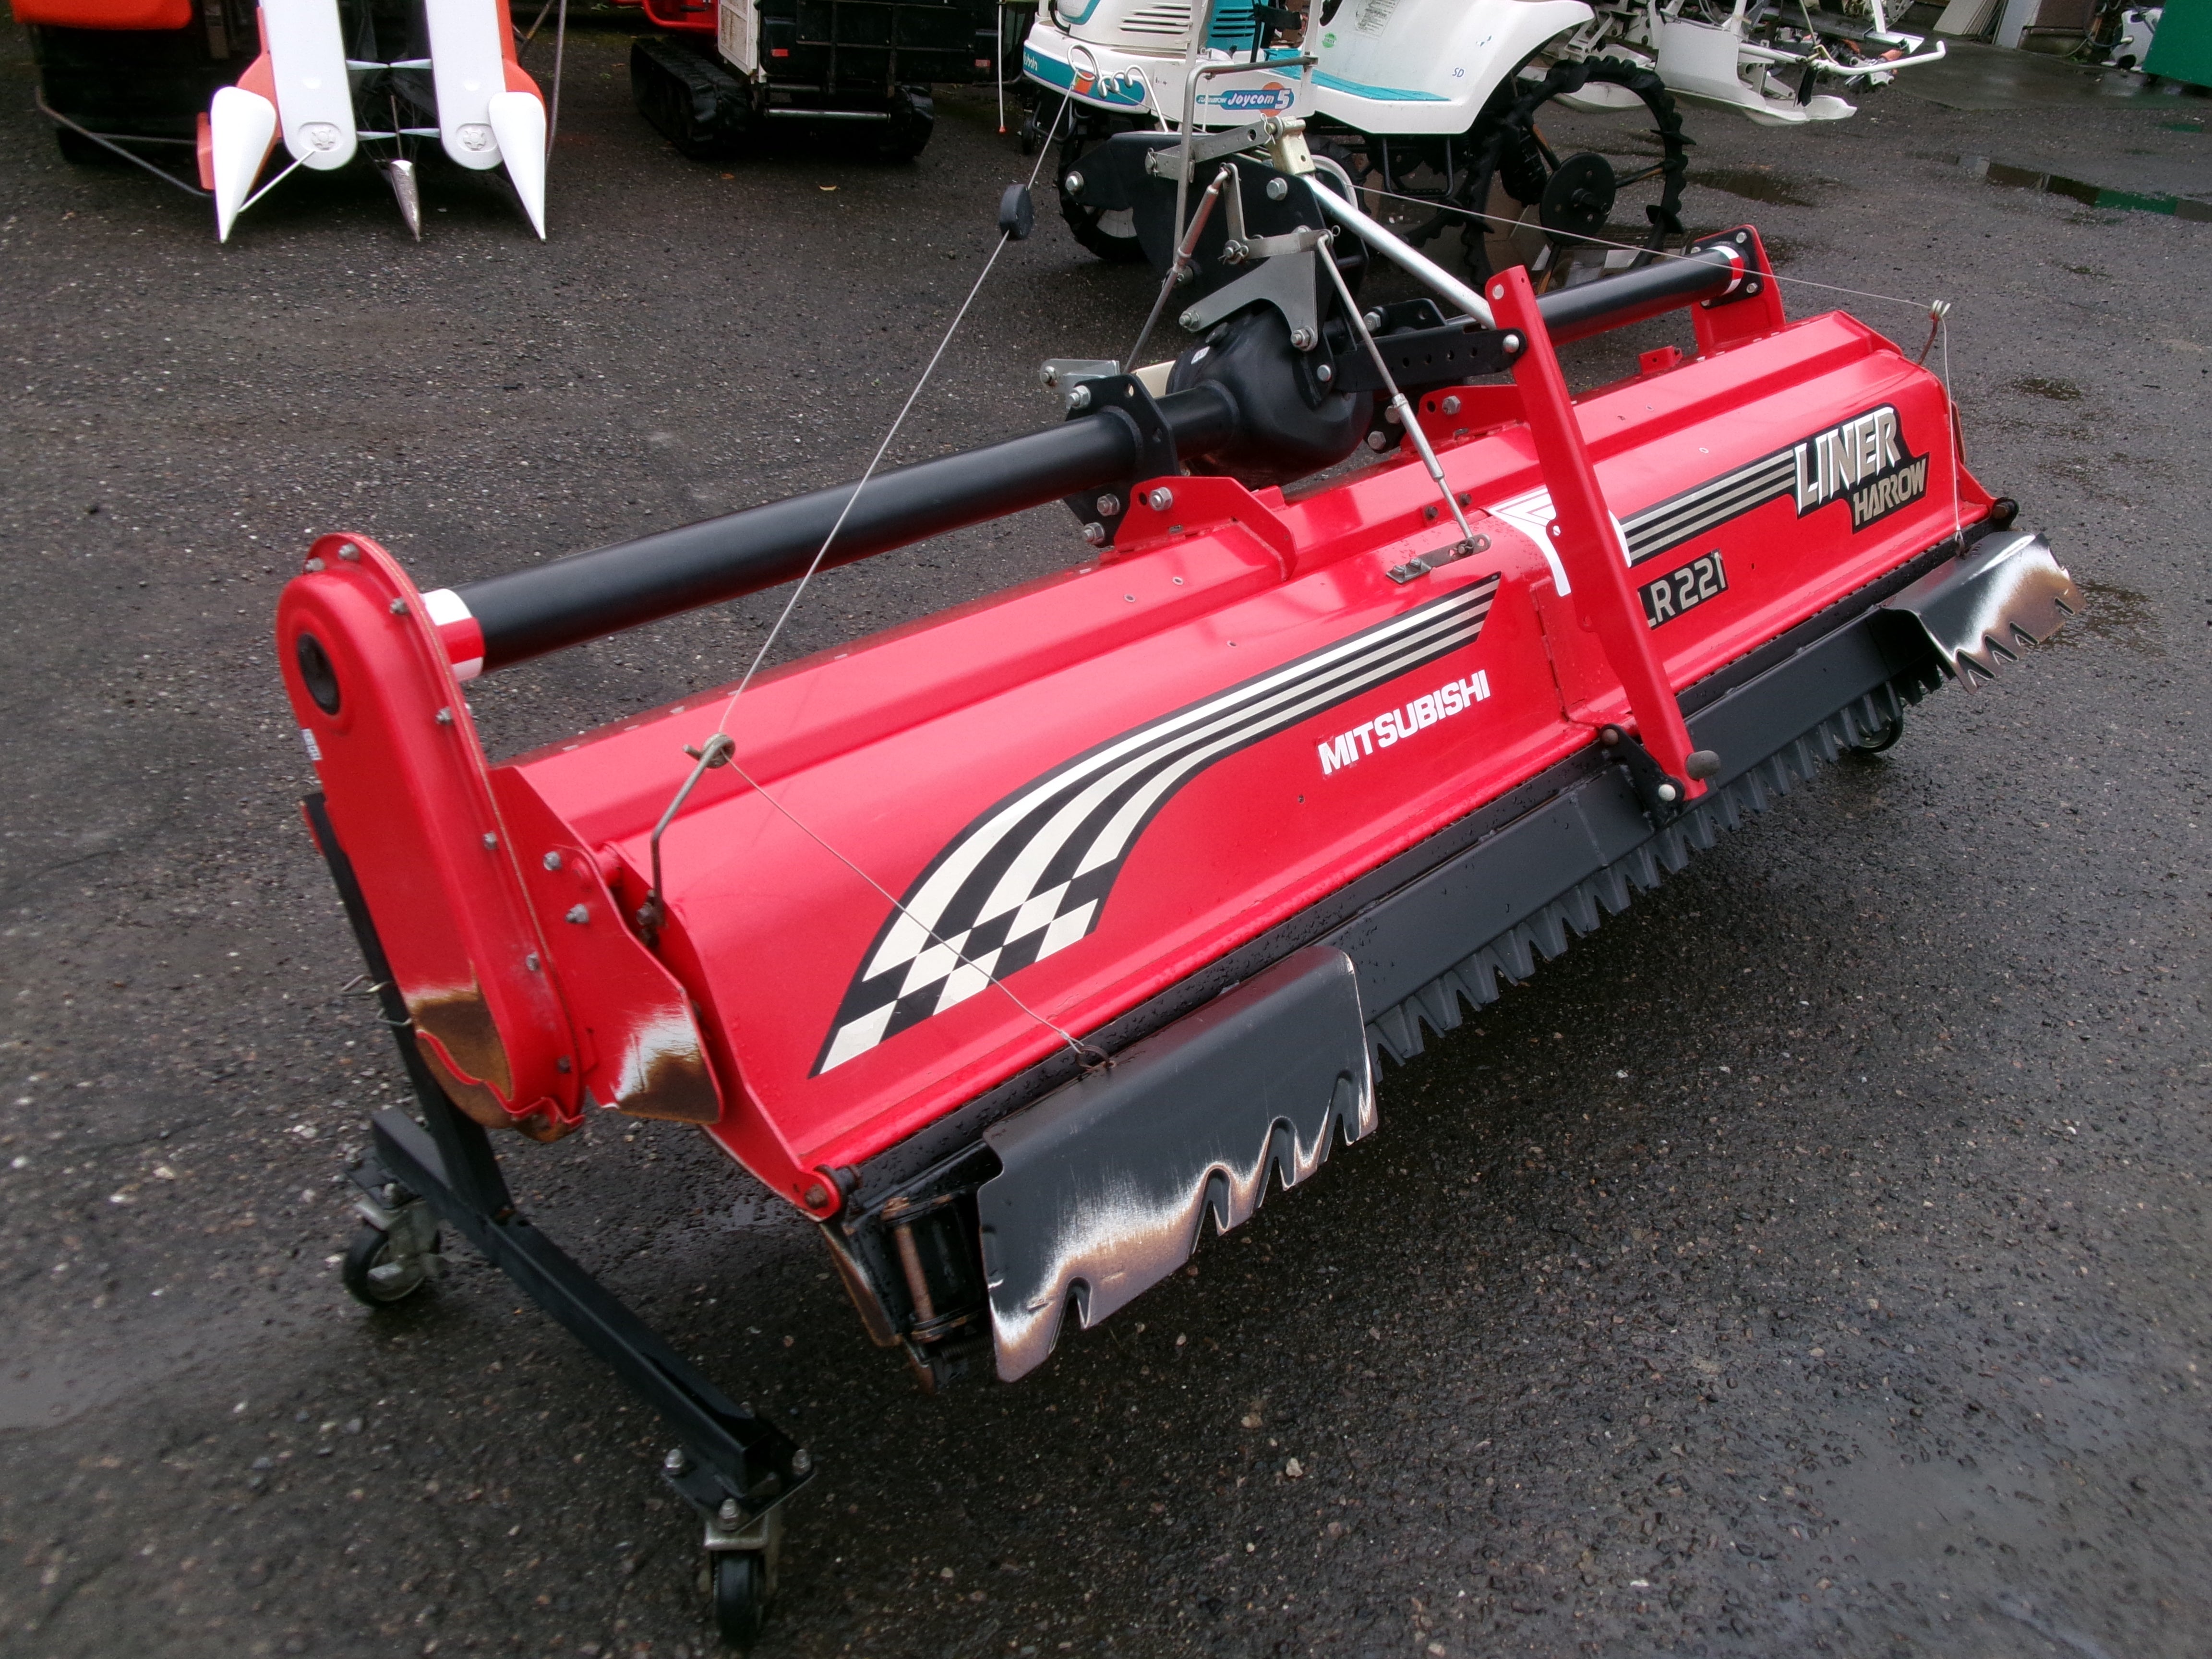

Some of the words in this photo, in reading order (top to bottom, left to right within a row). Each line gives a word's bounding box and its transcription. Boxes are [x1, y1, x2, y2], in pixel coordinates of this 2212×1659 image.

[1227, 93, 1274, 107] Joycom
[1274, 90, 1291, 109] 5
[1452, 67, 1465, 78] SD
[1794, 407, 1901, 516] LINER
[1853, 457, 1926, 527] HARROW
[1674, 552, 1726, 610] 221
[1317, 669, 1491, 775] MITSUBISHI
